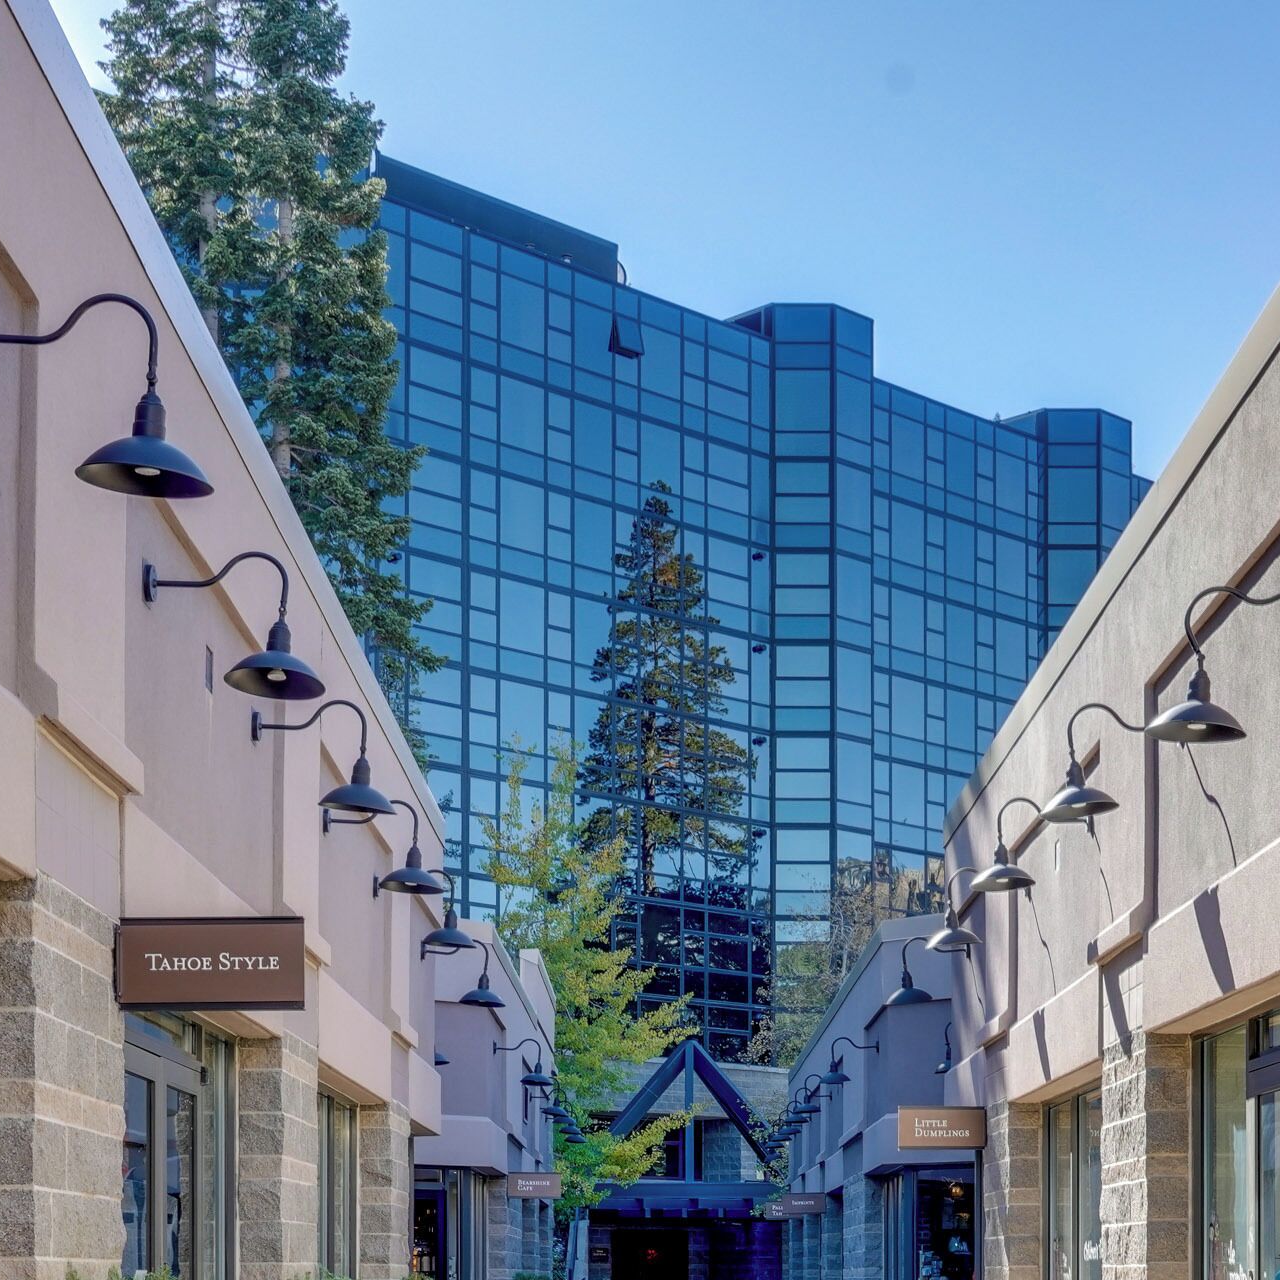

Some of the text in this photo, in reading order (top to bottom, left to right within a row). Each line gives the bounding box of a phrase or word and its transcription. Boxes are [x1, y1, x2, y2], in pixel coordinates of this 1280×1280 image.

[144, 952, 280, 971] TAHOE STYLE
[915, 1118, 948, 1127] LITTLE
[915, 1128, 970, 1137] DUMPLINGS
